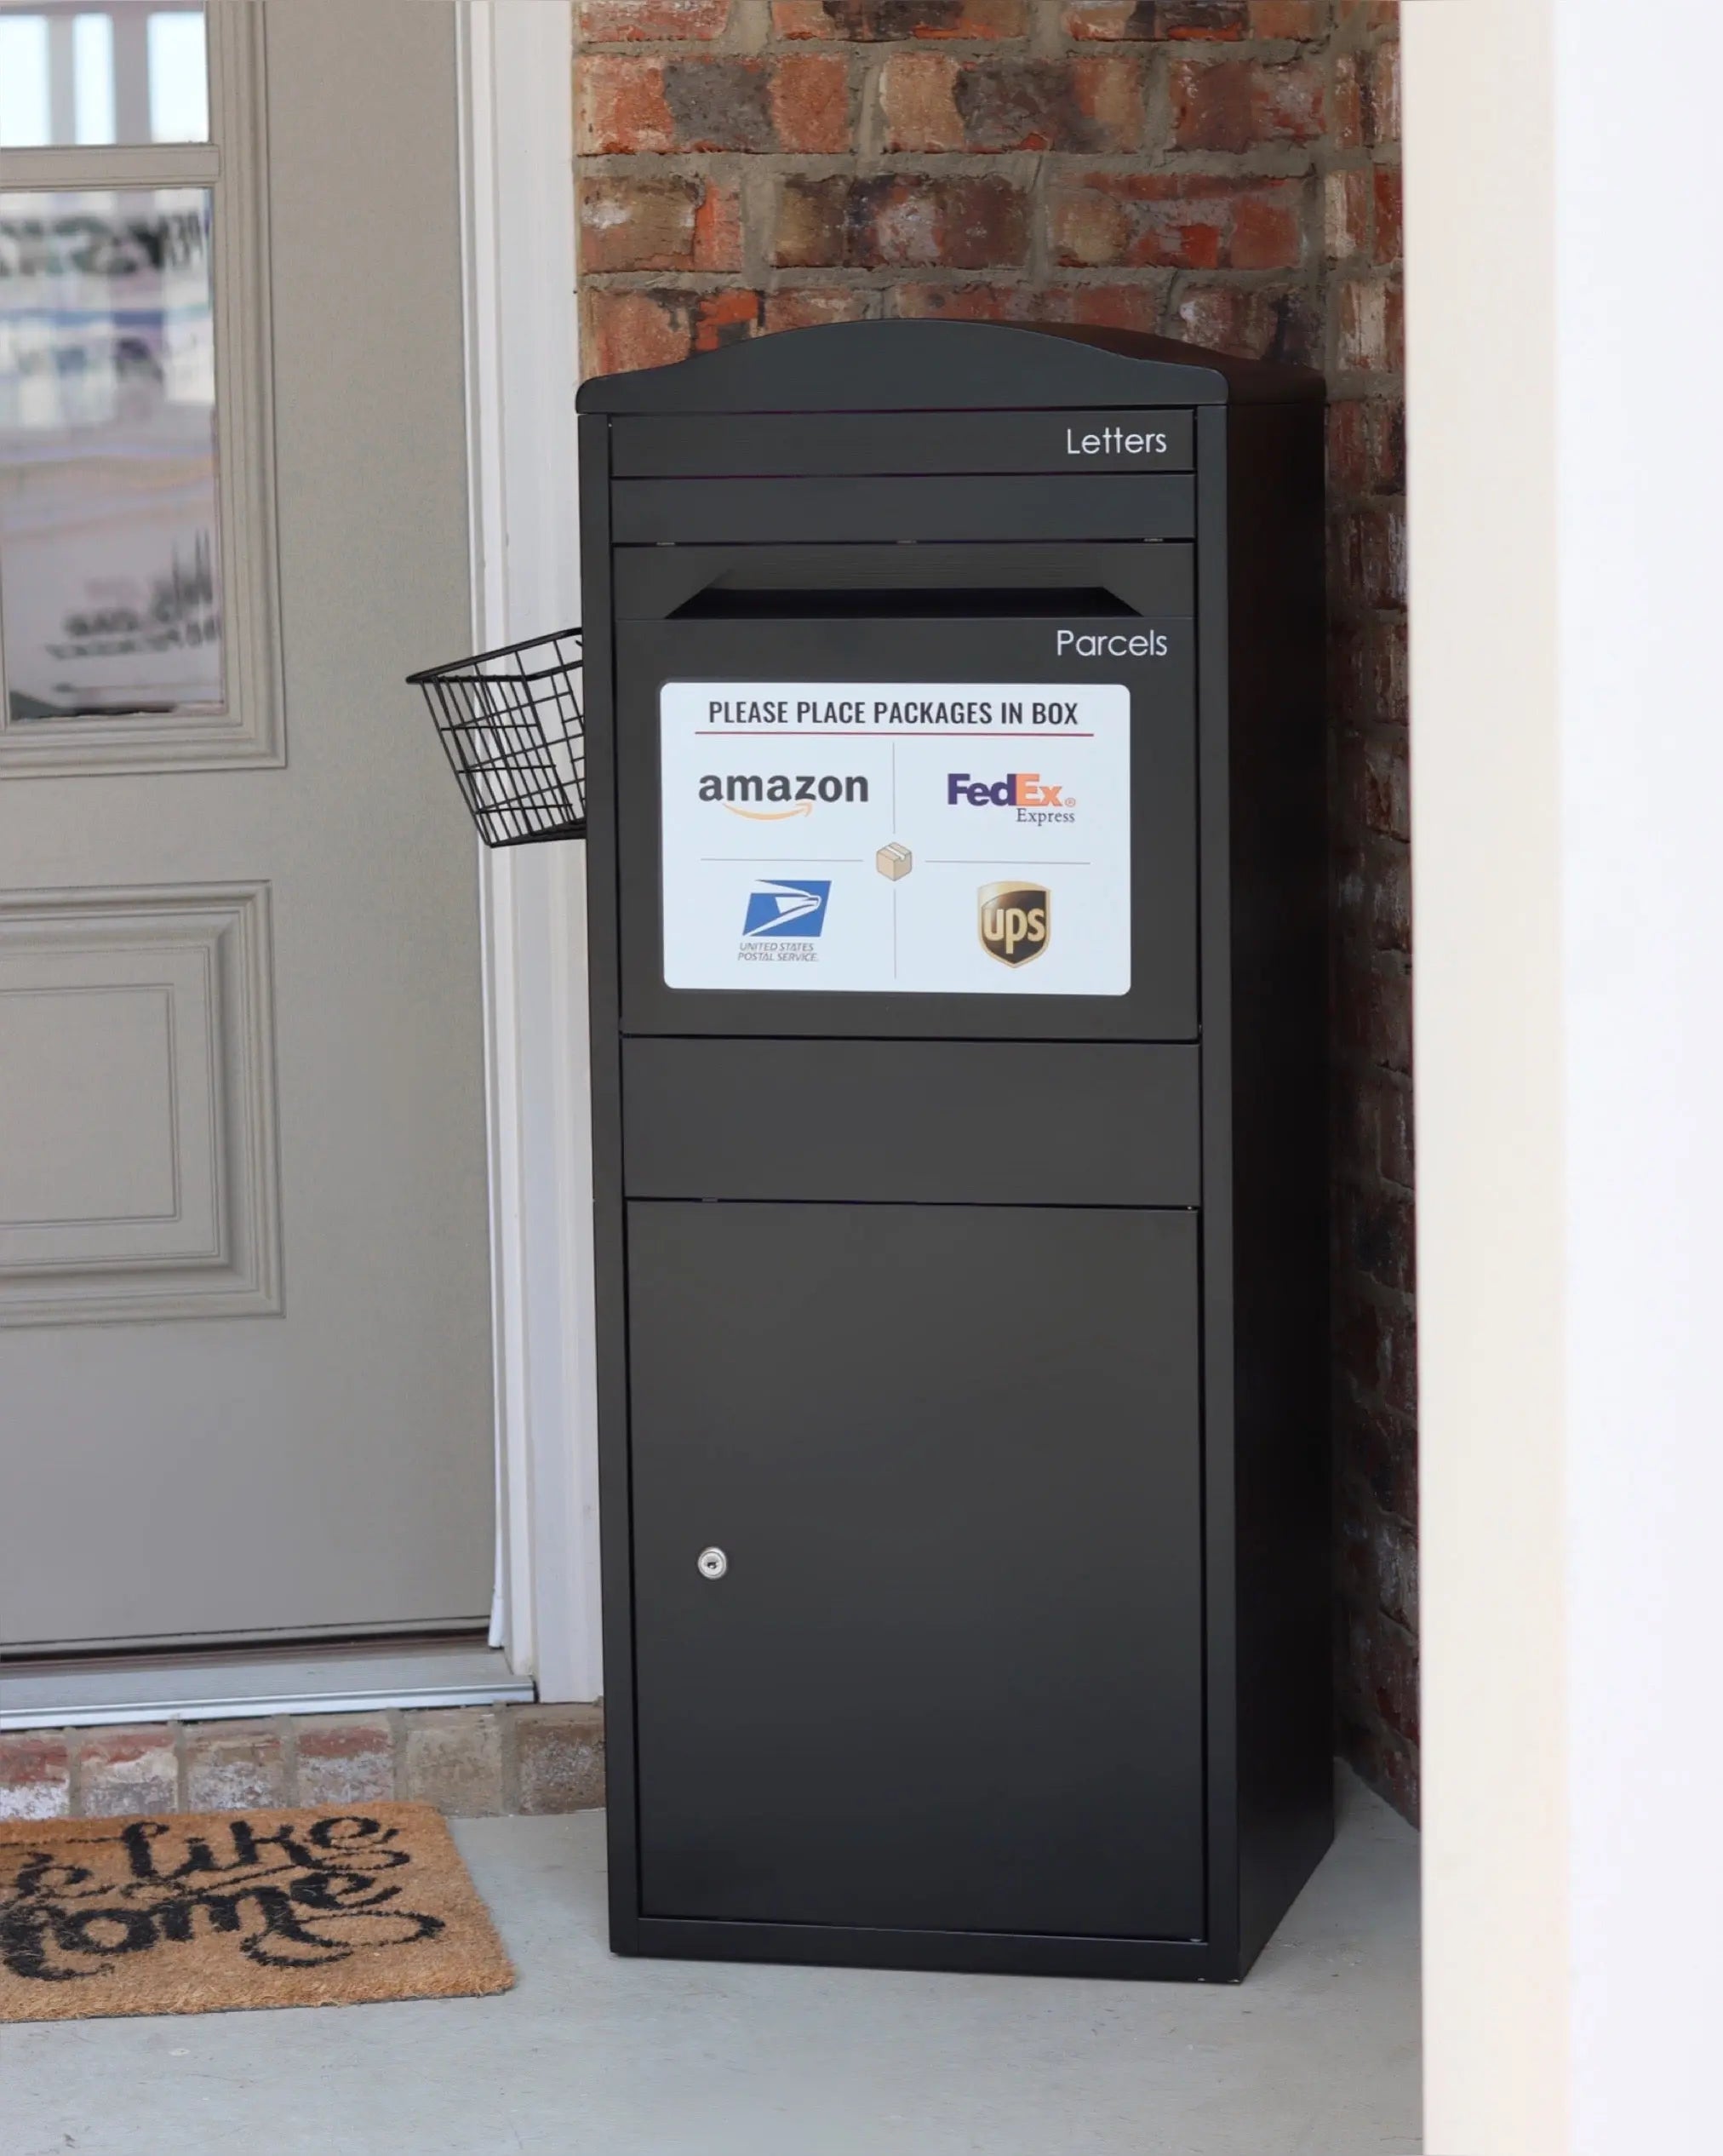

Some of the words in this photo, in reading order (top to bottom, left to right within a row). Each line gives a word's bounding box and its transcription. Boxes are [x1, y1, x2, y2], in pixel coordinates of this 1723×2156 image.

[1067, 427, 1167, 454] Letters
[1056, 628, 1167, 657] Parcels
[708, 701, 788, 724] PLEASE
[796, 701, 866, 724] PLACE
[873, 702, 993, 725] PACKAGES
[1000, 702, 1023, 725] IN
[1032, 702, 1079, 725] BOX
[698, 774, 868, 803] amazon
[1016, 807, 1076, 827] Express
[983, 908, 1046, 955] ups
[737, 952, 775, 961] POSTAL
[776, 952, 818, 962] SERVICE
[739, 942, 778, 952] UNITED
[779, 943, 815, 952] STATES
